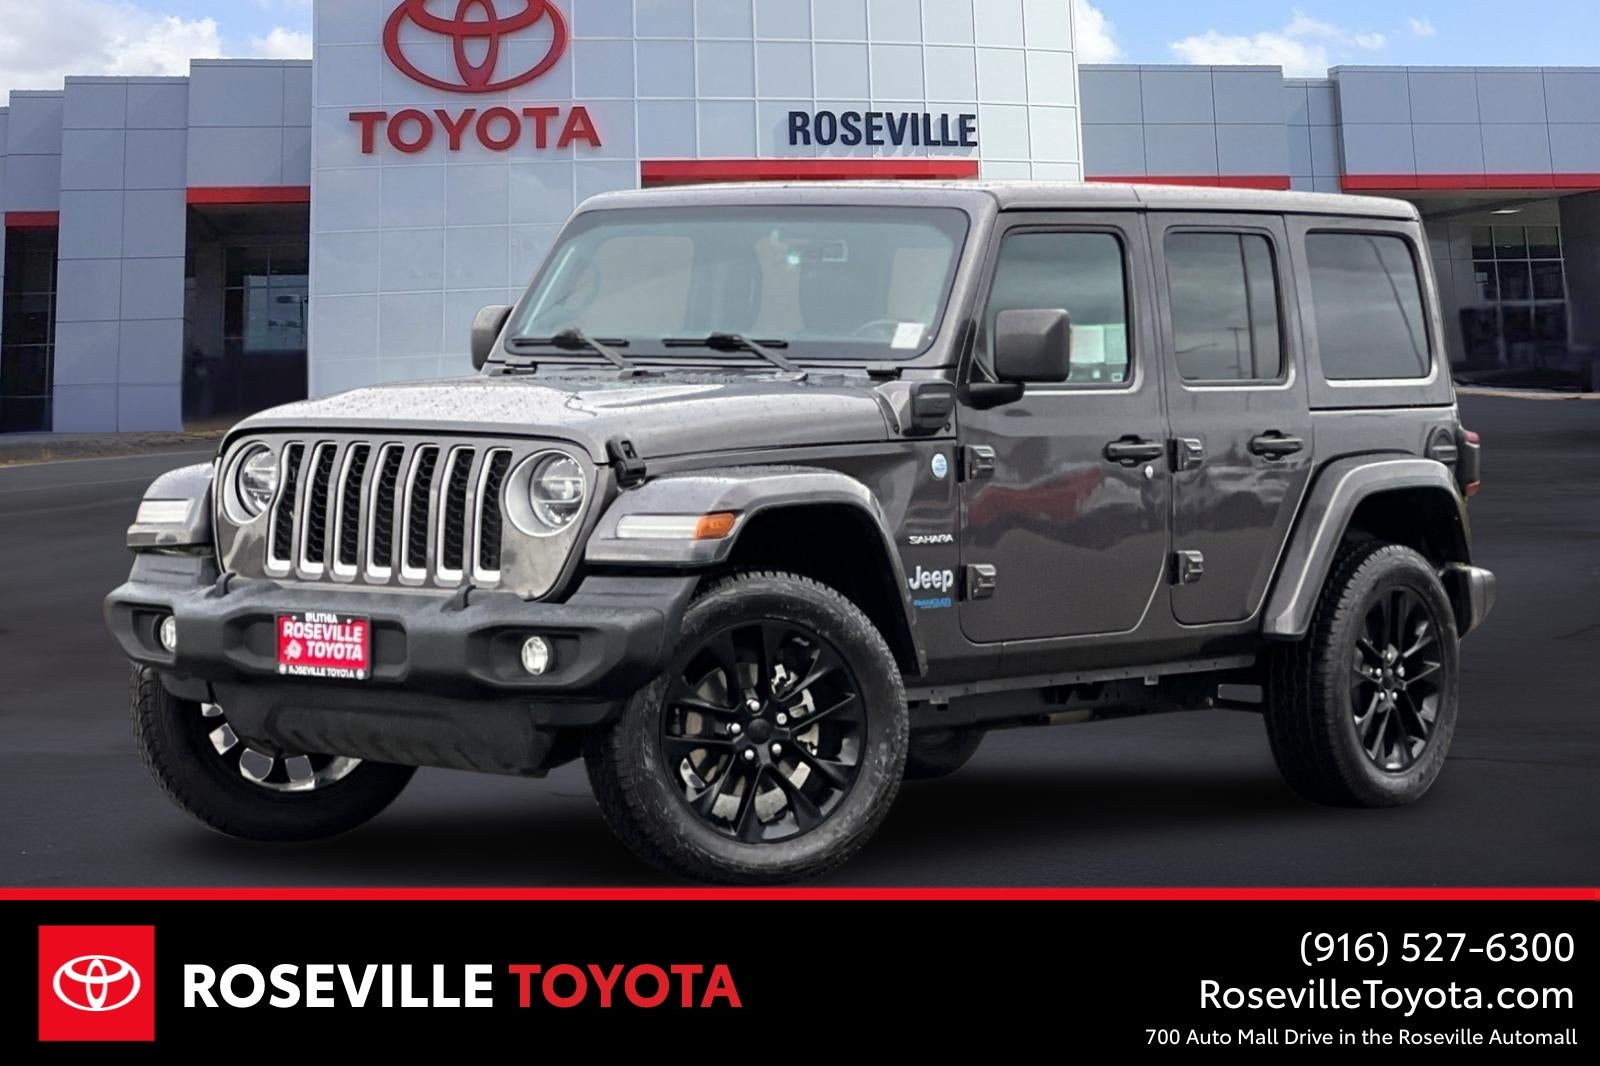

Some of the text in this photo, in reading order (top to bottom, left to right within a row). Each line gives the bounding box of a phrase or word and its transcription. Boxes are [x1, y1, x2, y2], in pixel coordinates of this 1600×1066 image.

[350, 106, 602, 154] TOYOTA
[788, 110, 978, 147] ROSEVILLE
[908, 533, 954, 545] SAHARA
[908, 565, 955, 593] Jeep
[283, 621, 363, 643] ROSEVILLE
[306, 641, 363, 660] TOYOTA
[327, 667, 355, 678] TOYOTA
